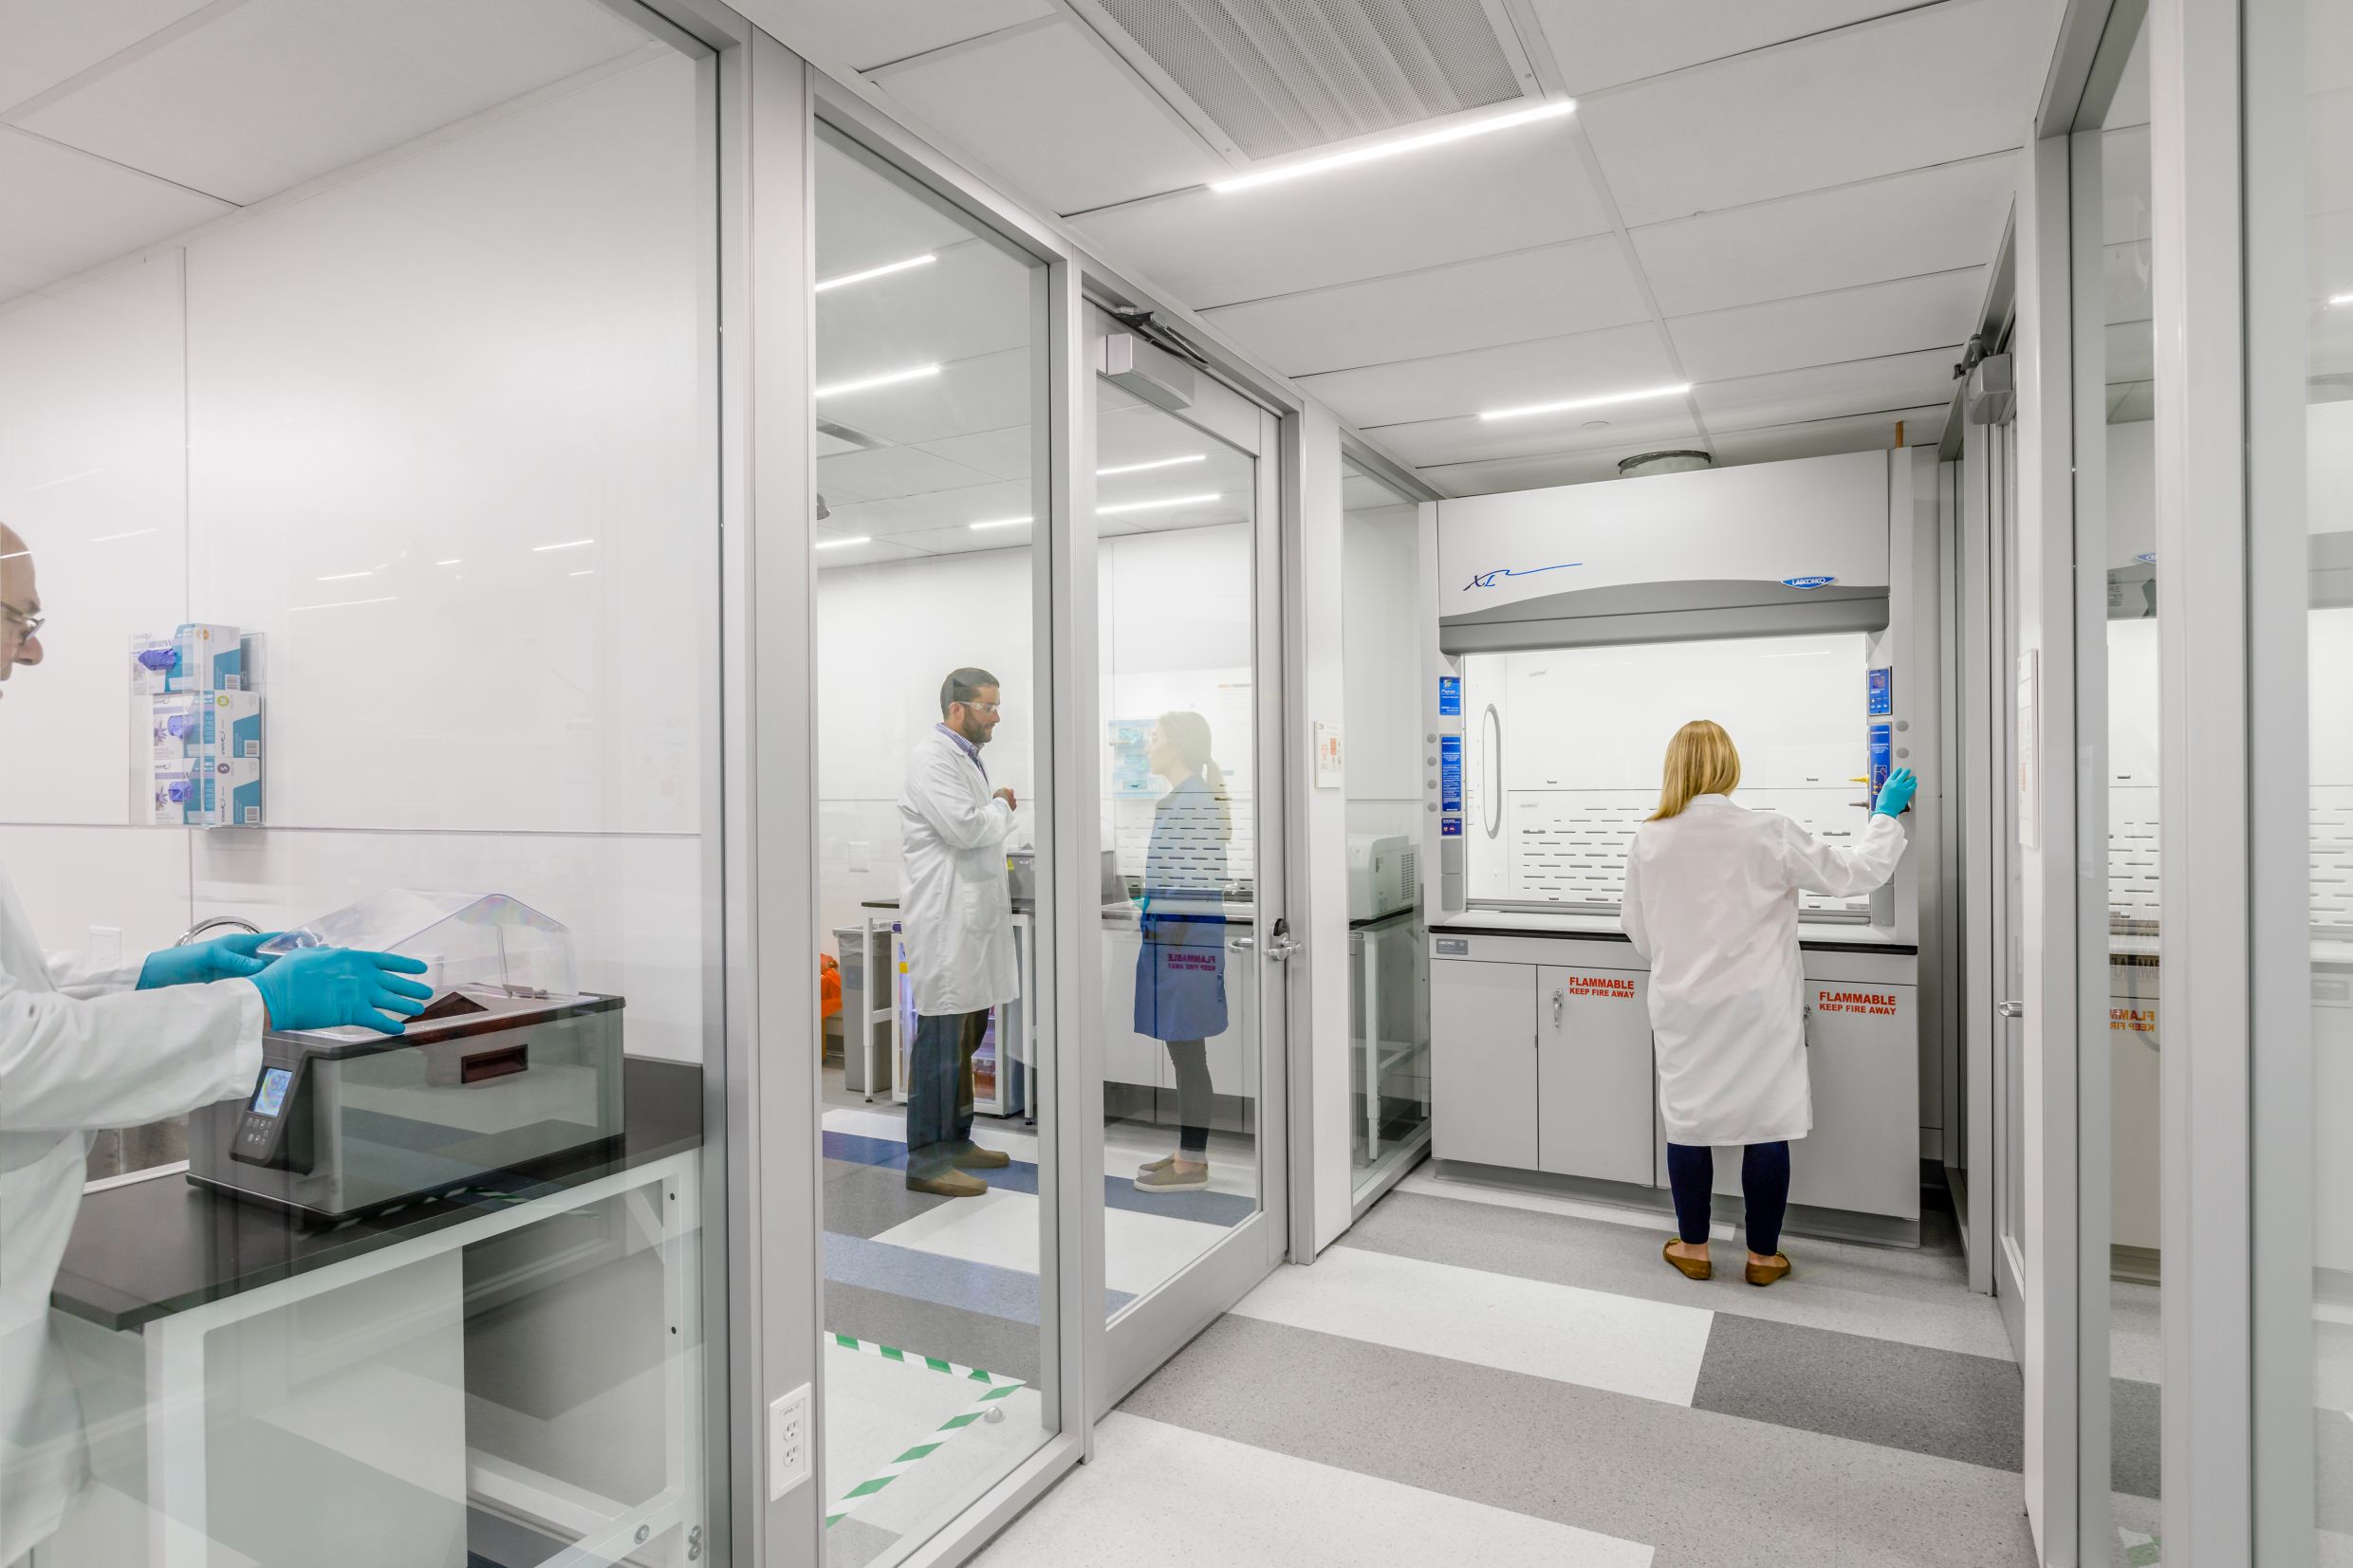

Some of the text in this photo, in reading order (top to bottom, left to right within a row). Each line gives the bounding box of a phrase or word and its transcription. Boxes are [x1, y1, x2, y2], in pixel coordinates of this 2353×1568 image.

[1569, 977, 1635, 990] FLAMMABLE
[1569, 987, 1590, 996] KEEP
[1611, 990, 1635, 999] AWAY
[1819, 991, 1897, 1005] FLAMMABLE
[1819, 1004, 1897, 1015] KEEP FIRE AWAY
